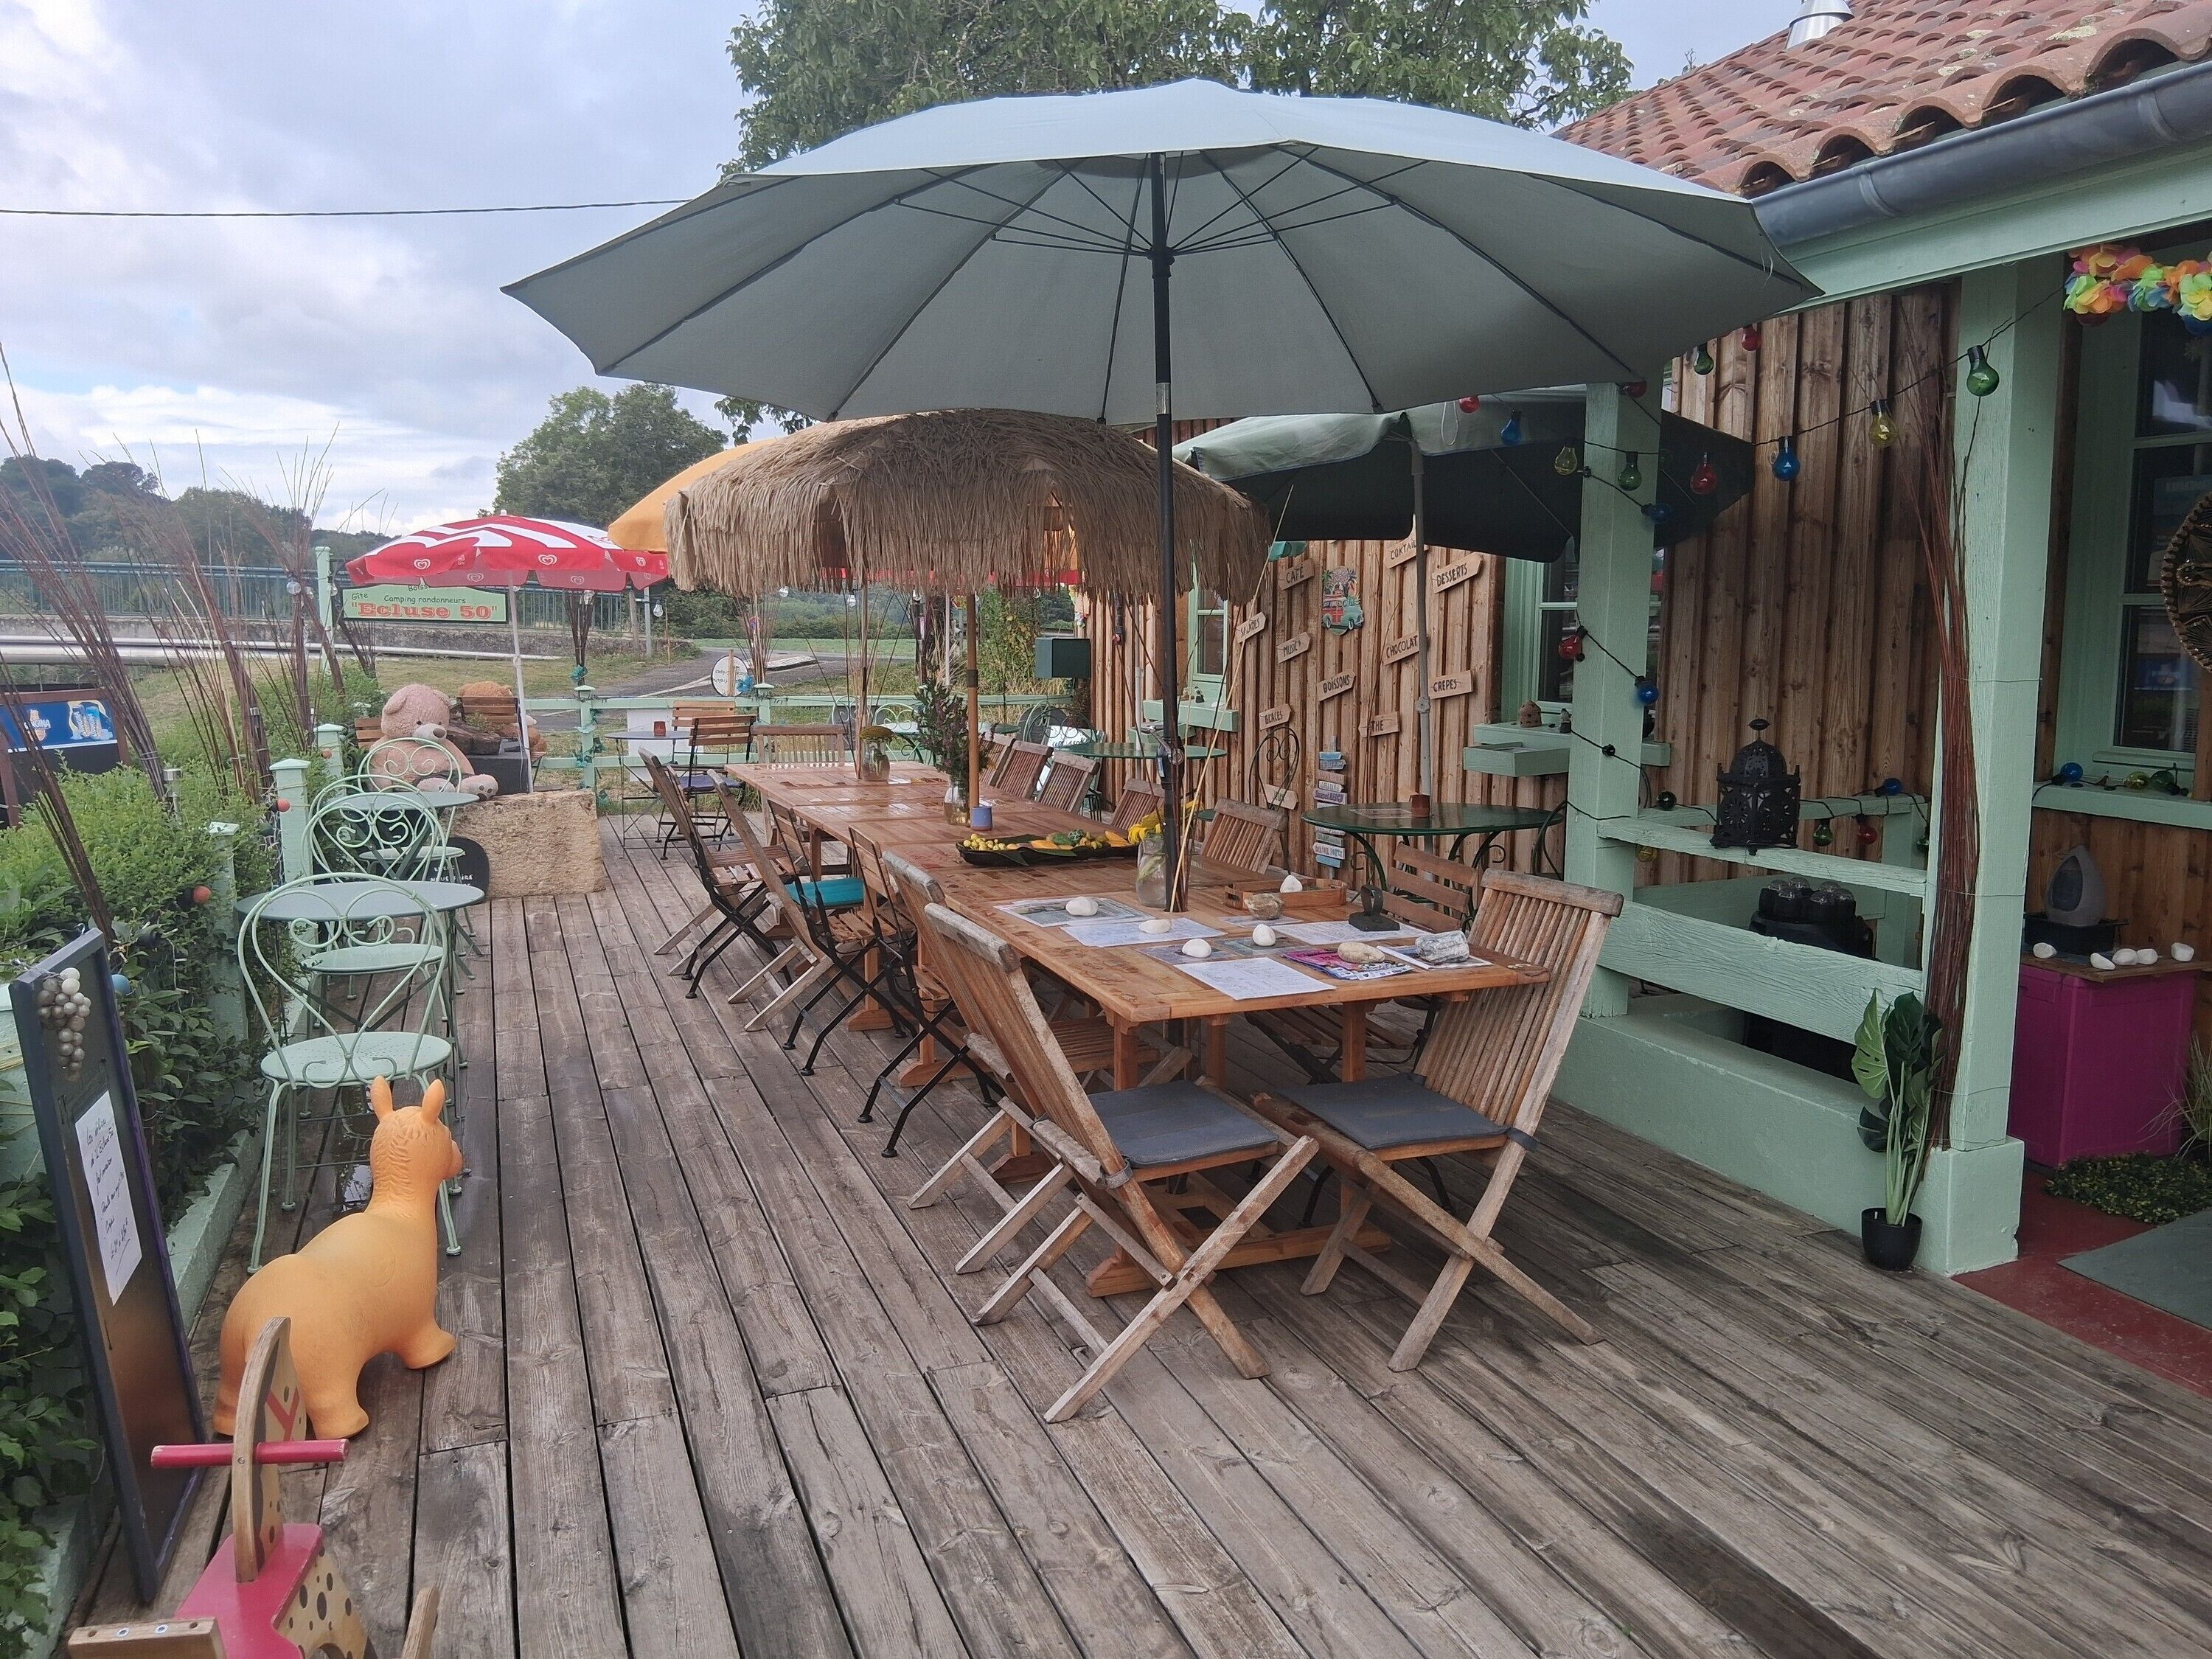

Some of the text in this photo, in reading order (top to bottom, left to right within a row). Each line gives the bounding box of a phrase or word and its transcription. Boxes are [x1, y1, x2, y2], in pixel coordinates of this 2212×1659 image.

[1436, 563, 1468, 587] DESSERTS
[352, 592, 369, 600] Gîte
[383, 595, 466, 605] Camping randonneurs
[459, 605, 497, 620] 50"
[1386, 635, 1418, 658] CHOCOLAT
[1322, 674, 1350, 694] BOISSONS
[1433, 679, 1457, 692] CREPES
[1265, 710, 1283, 725] GLACES
